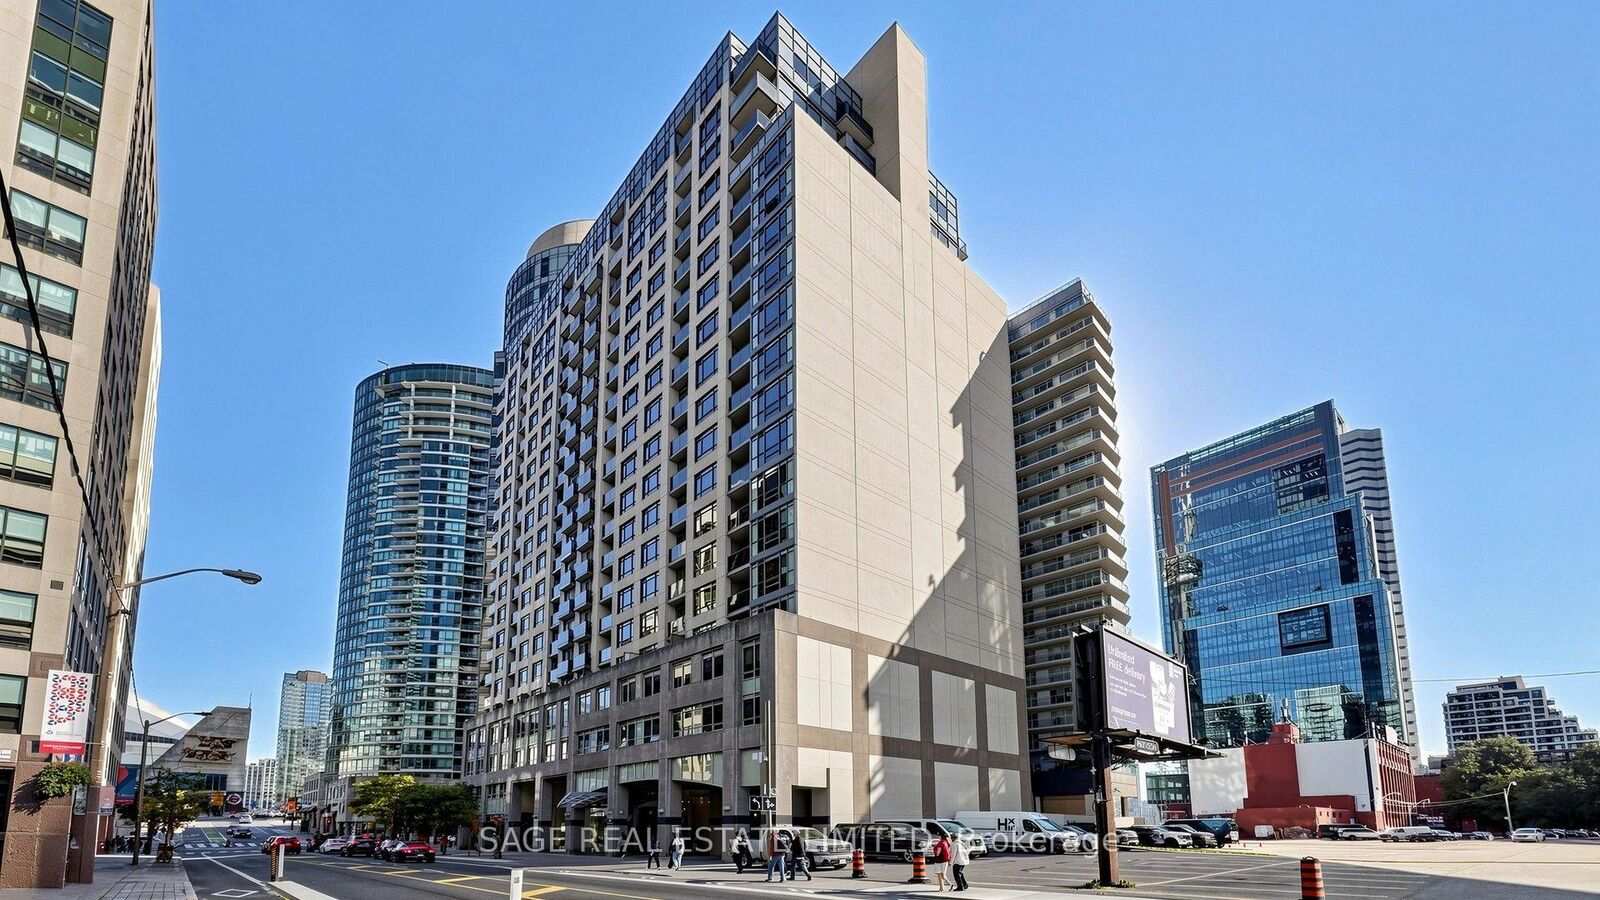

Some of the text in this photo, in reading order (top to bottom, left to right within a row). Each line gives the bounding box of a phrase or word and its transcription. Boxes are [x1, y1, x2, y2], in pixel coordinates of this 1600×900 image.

[1107, 643, 1135, 665] Unlimited
[1108, 657, 1124, 673] FREE
[1124, 663, 1147, 685] delivery
